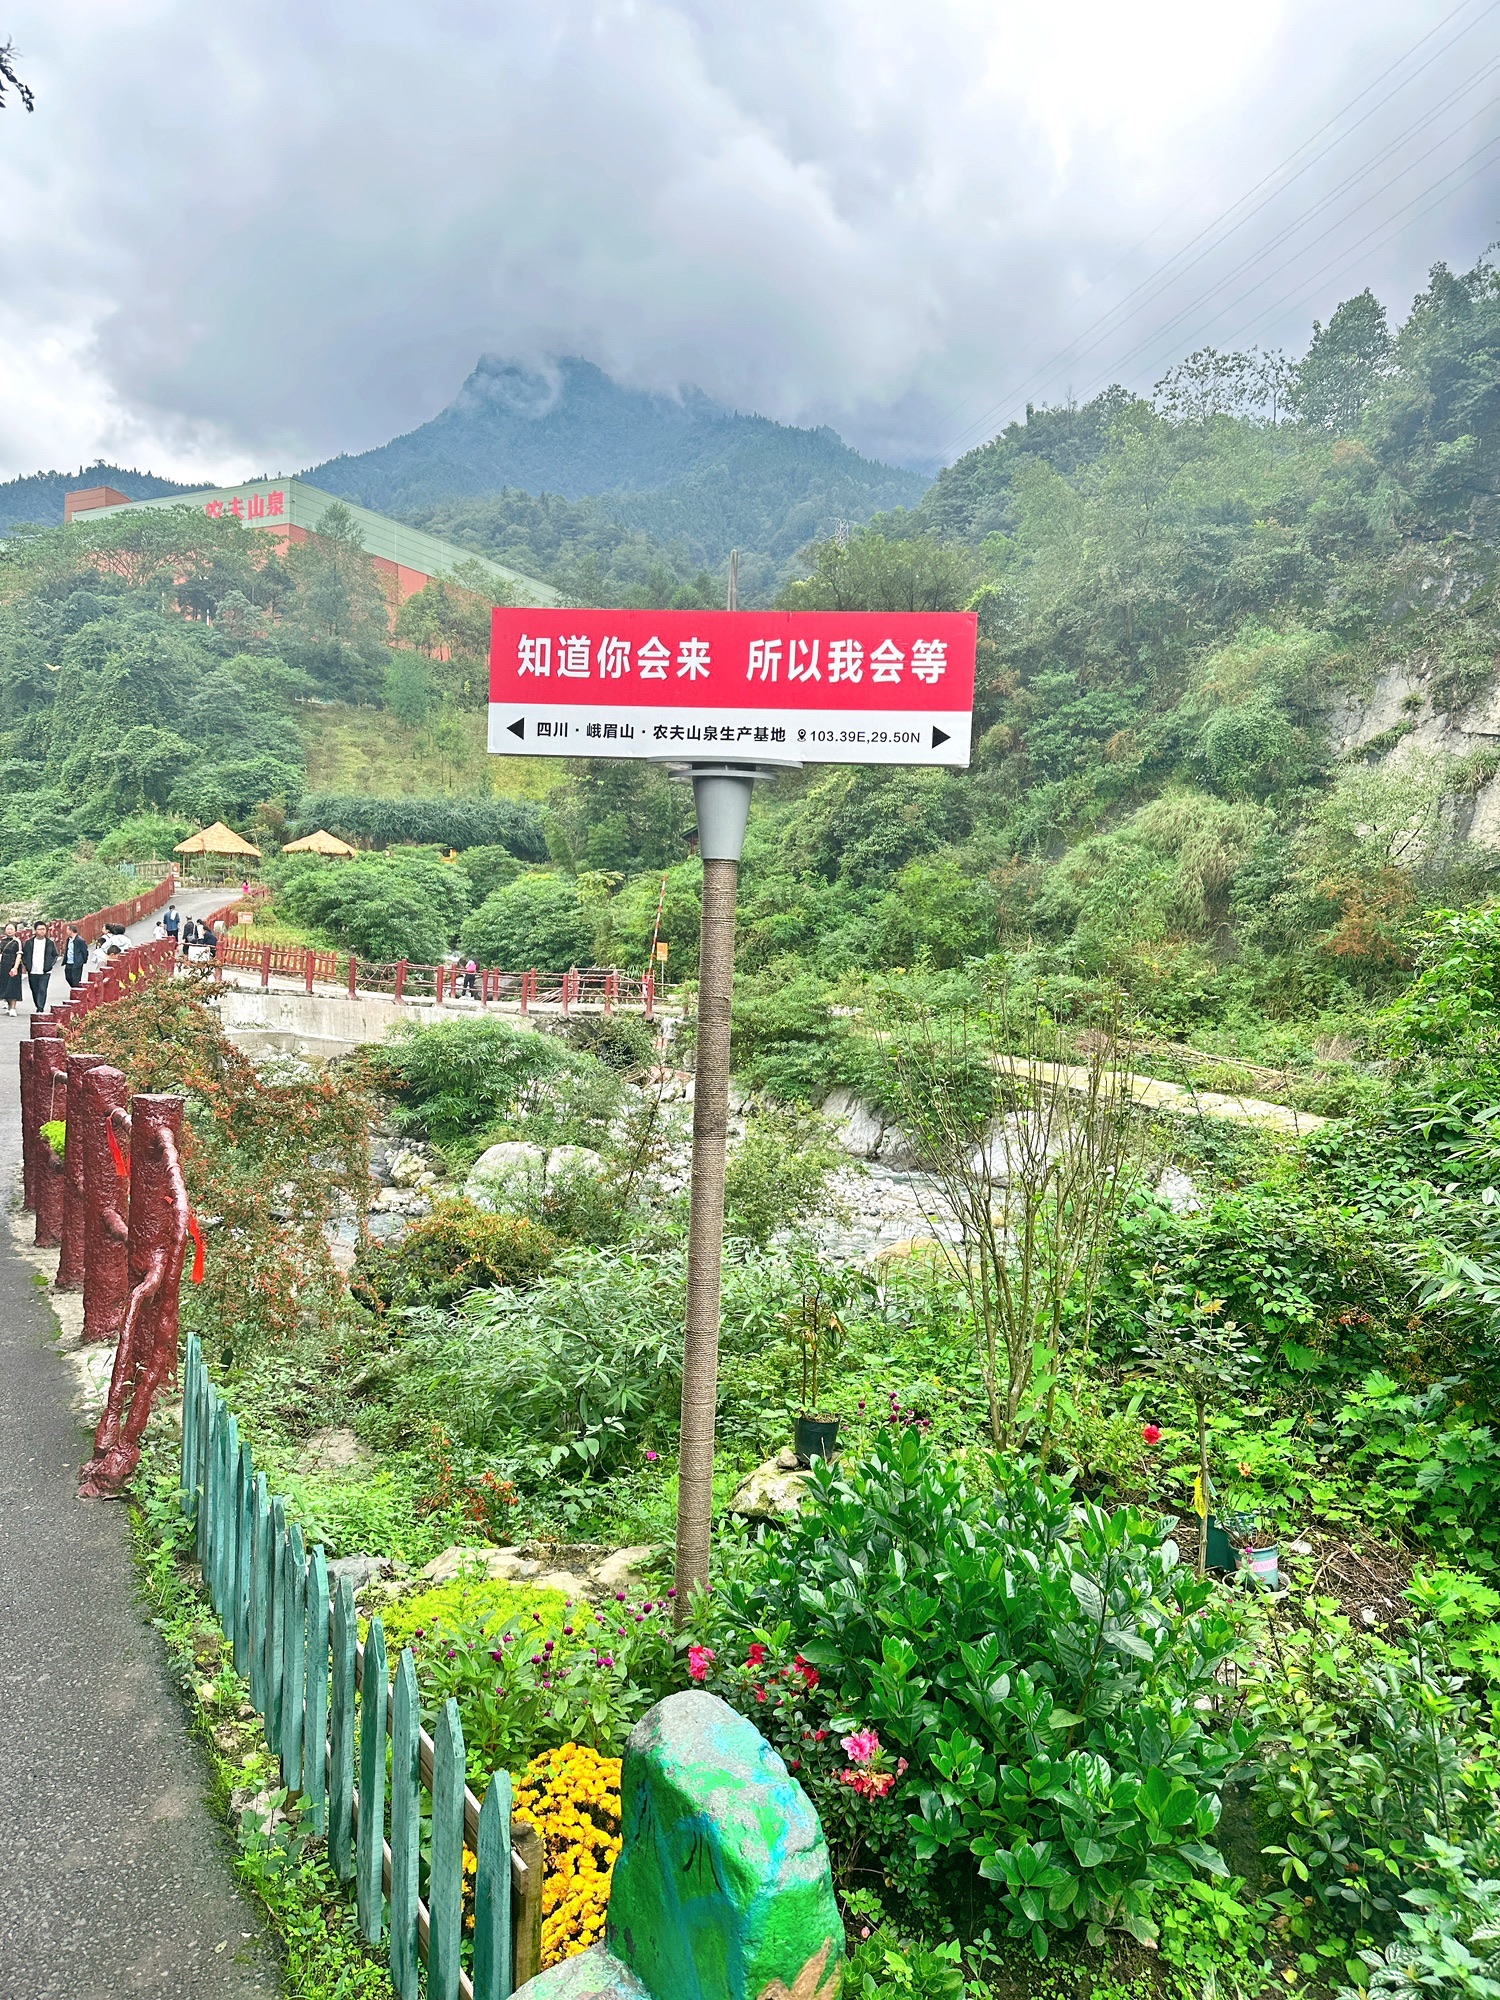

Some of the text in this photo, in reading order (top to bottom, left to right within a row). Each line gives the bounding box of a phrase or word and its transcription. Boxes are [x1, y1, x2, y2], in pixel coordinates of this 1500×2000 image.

[205, 490, 284, 520] 农夫山泉
[516, 634, 948, 685] 知道你会来 所以我会等
[810, 730, 921, 744] 103.39E,29.50N
